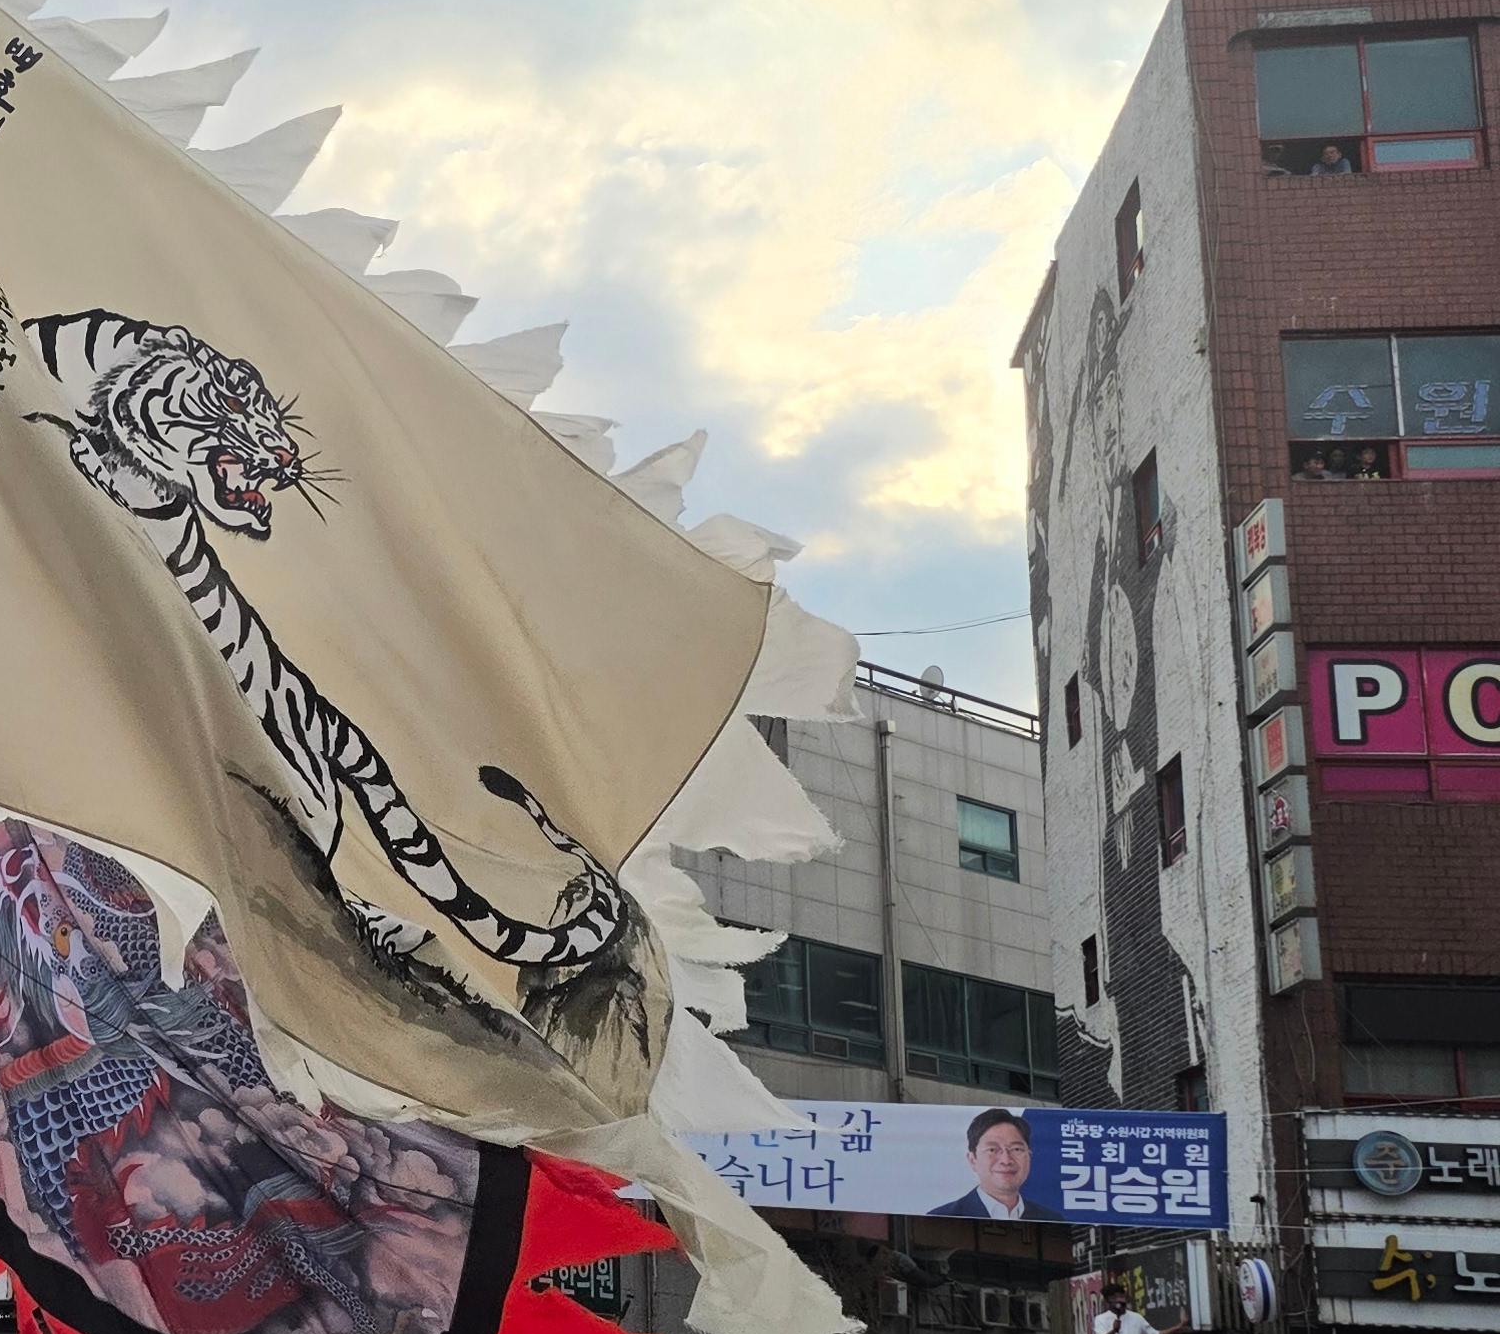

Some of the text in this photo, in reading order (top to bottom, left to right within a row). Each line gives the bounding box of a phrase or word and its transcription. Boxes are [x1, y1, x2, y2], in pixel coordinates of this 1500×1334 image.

[1303, 380, 1492, 434] 수원
[1060, 1123, 1210, 1140] 민주당 수원시갑 지역위원회
[698, 1153, 844, 1205] 습니다
[1363, 1141, 1409, 1185] 준
[1060, 1165, 1212, 1216] 김승원
